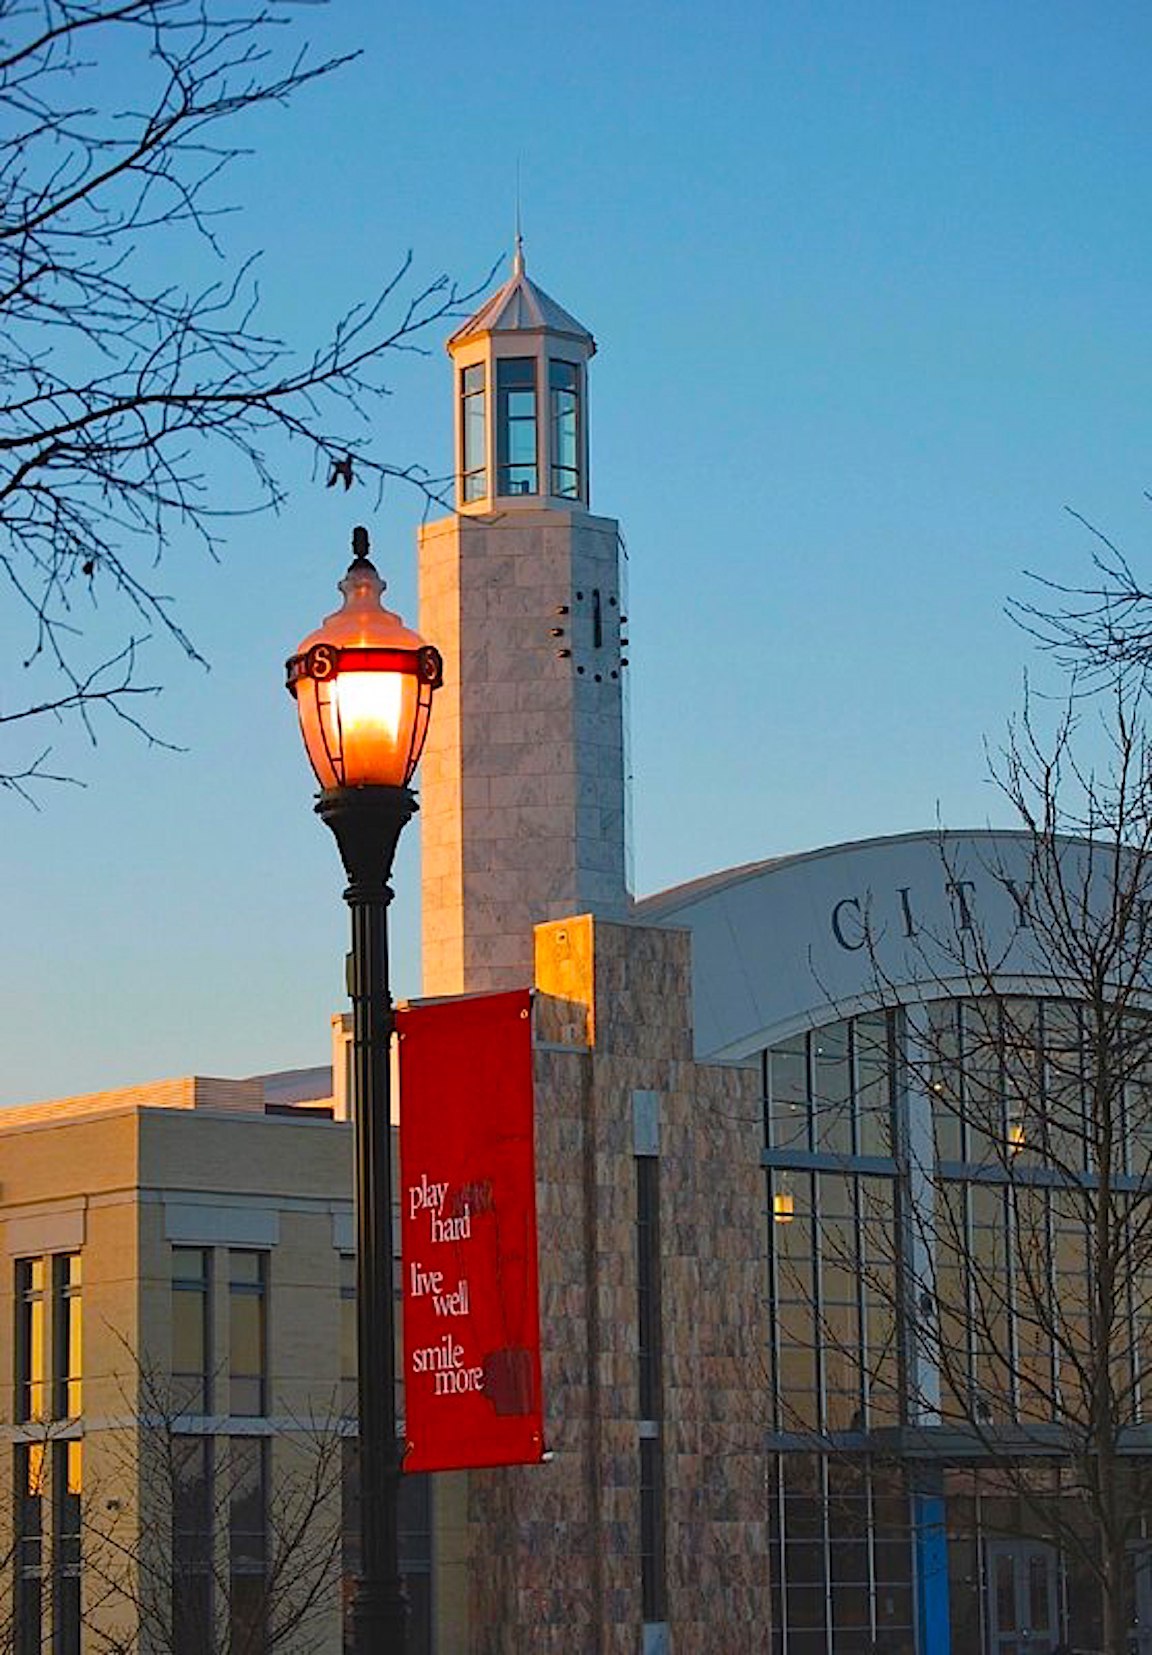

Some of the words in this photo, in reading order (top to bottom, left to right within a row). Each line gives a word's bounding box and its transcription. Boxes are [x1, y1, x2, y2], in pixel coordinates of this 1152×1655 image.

[831, 881, 1037, 951] CITY
[409, 1174, 449, 1219] play
[431, 1203, 471, 1243] hard
[411, 1261, 443, 1296] live
[432, 1280, 469, 1316] well
[412, 1334, 464, 1372] smile
[434, 1366, 484, 1395] more
